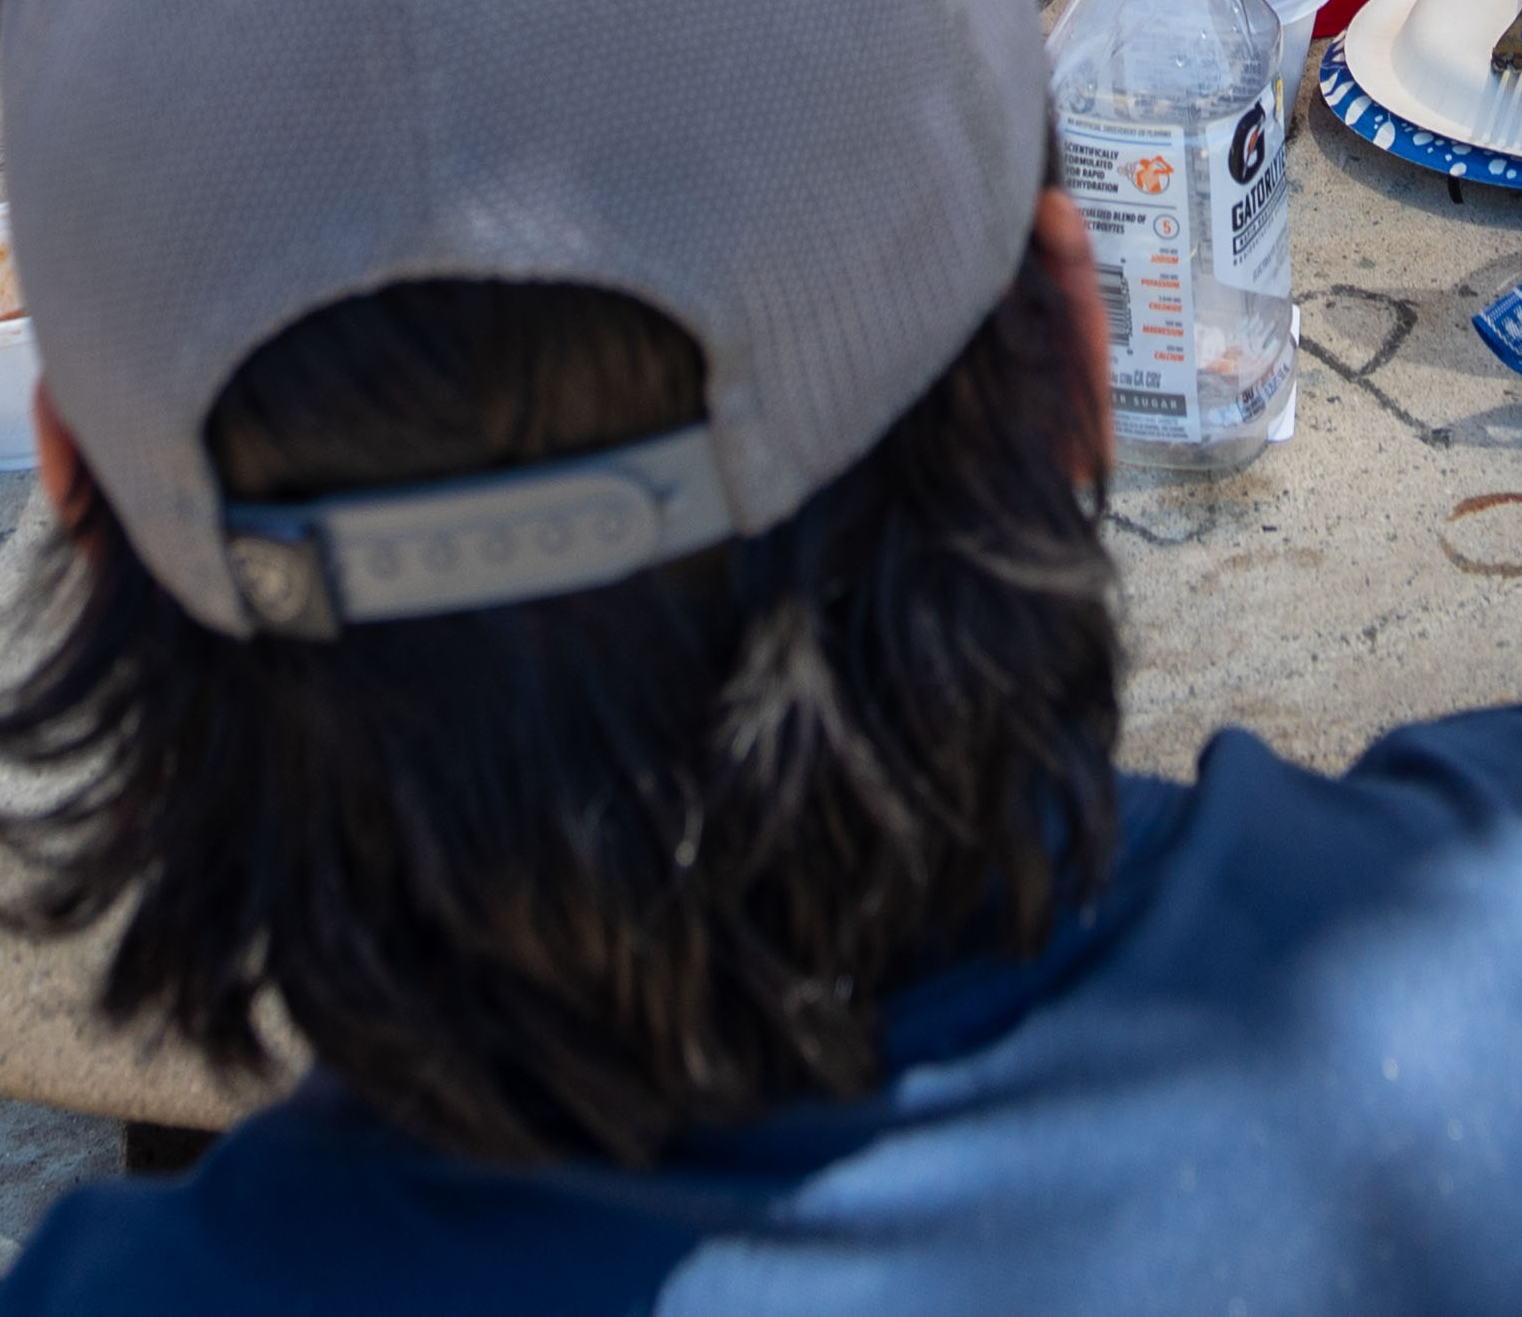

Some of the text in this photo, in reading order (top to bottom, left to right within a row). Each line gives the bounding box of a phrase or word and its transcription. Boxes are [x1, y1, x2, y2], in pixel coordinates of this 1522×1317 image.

[1064, 140, 1120, 160] SCIENTIFICALLY
[1228, 98, 1266, 186] G
[1064, 153, 1114, 171] FORMULATED
[1082, 168, 1106, 180] RAPID
[1113, 211, 1136, 223] BLEND
[1137, 213, 1148, 225] OF
[1162, 218, 1172, 235] 5
[1133, 393, 1178, 409] SUGAR
